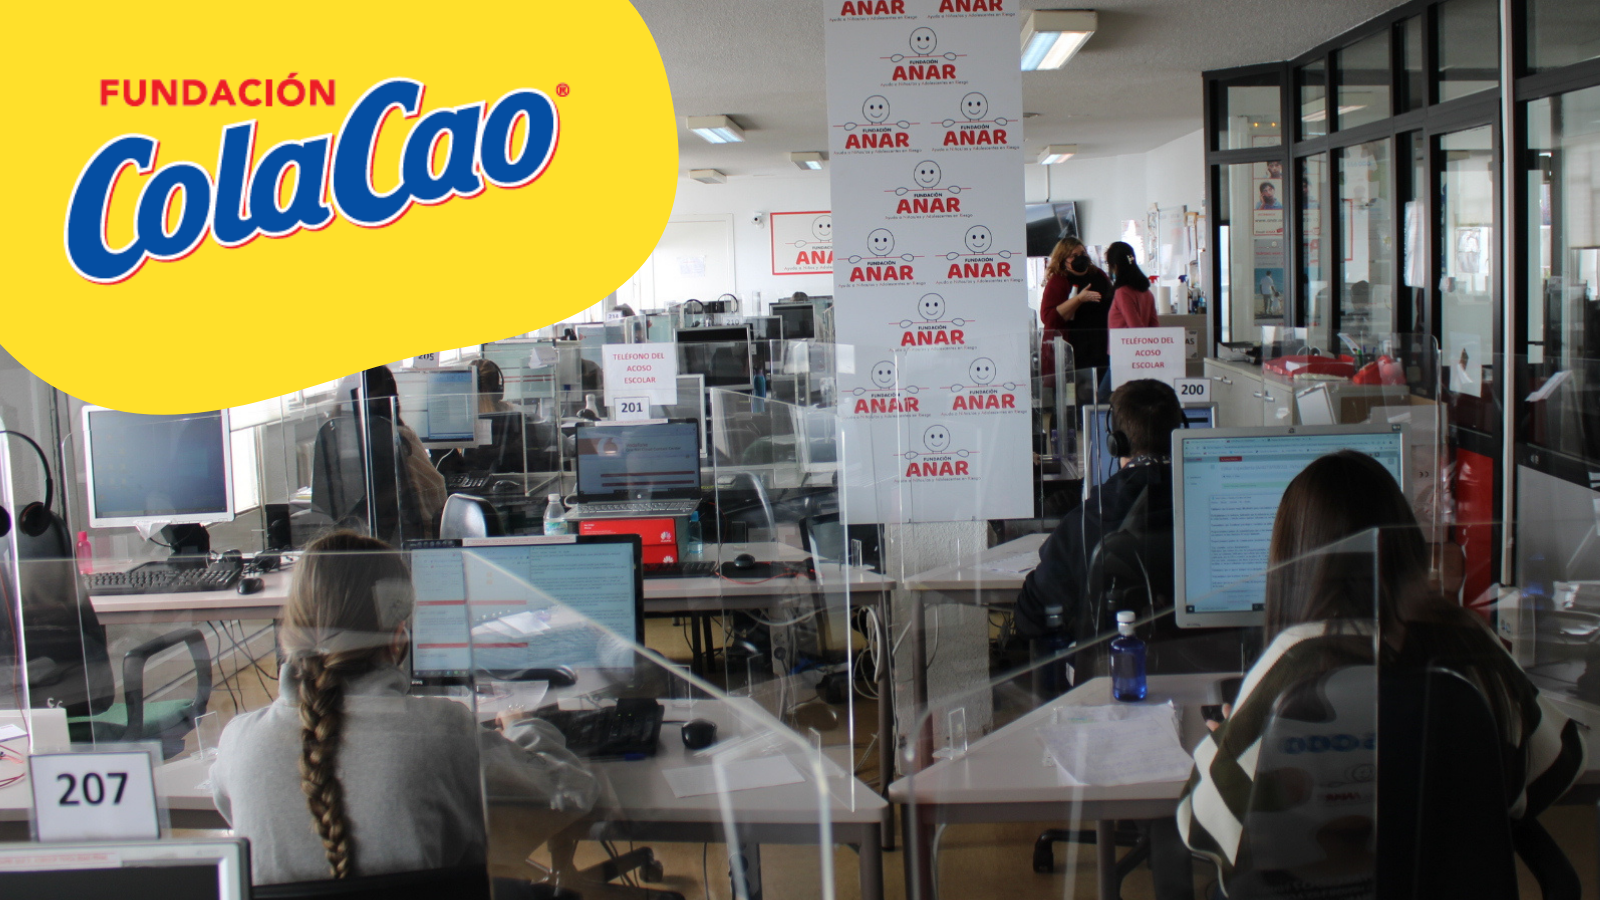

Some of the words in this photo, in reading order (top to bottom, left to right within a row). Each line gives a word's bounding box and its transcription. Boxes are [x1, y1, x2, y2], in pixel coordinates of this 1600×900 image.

[841, 0, 906, 16] ANAR
[939, 0, 1004, 13] ANAR
[892, 64, 956, 81] ANAR
[845, 132, 909, 150] ANAR
[943, 129, 1007, 146] ANAR
[896, 197, 960, 214] ANAR
[796, 251, 833, 265] AN
[849, 265, 914, 282] ANAR
[947, 262, 1011, 279] ANAR
[900, 329, 965, 347] ANAR
[1121, 336, 1159, 345] TELÉFONO
[613, 352, 650, 360] TELÉFONO
[1181, 384, 1204, 395] 200
[621, 402, 643, 413] 201
[854, 397, 919, 414] ANAR
[952, 394, 1015, 410] ANAR
[905, 461, 969, 477] ANAR
[56, 772, 128, 806] 207
